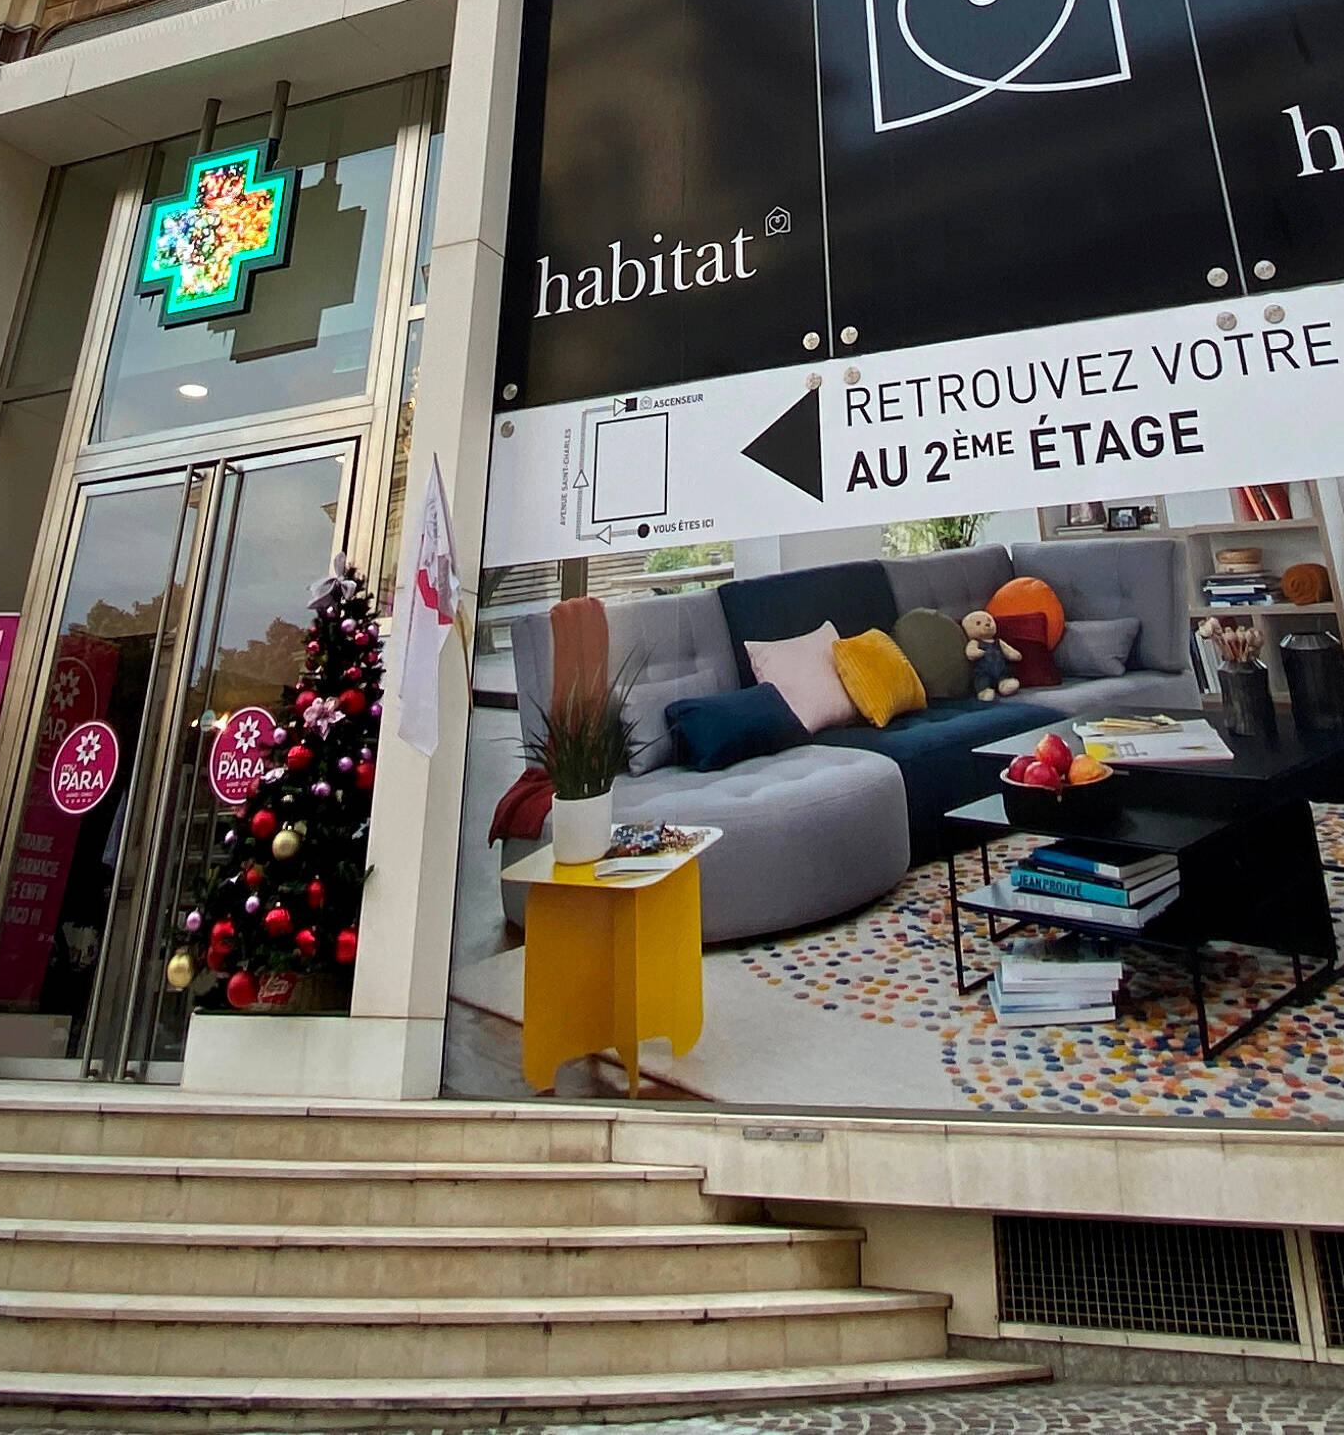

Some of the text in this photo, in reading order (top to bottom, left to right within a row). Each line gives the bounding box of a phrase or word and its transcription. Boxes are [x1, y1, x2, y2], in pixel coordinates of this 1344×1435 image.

[533, 226, 757, 319] habitat
[846, 349, 1138, 427] RETROUVEZ
[1151, 321, 1340, 385] VOTRE
[654, 393, 704, 408] ASCENSEUR
[845, 409, 1204, 493] AU 2ÈME ÉTAGE
[559, 428, 572, 526] AVENUE SAINT-CHARLES
[653, 518, 714, 533] VOUS ÊTES ICI
[57, 770, 104, 791] PARA
[217, 757, 264, 780] PARA
[1017, 873, 1083, 898] JEAN PROUVÉ
